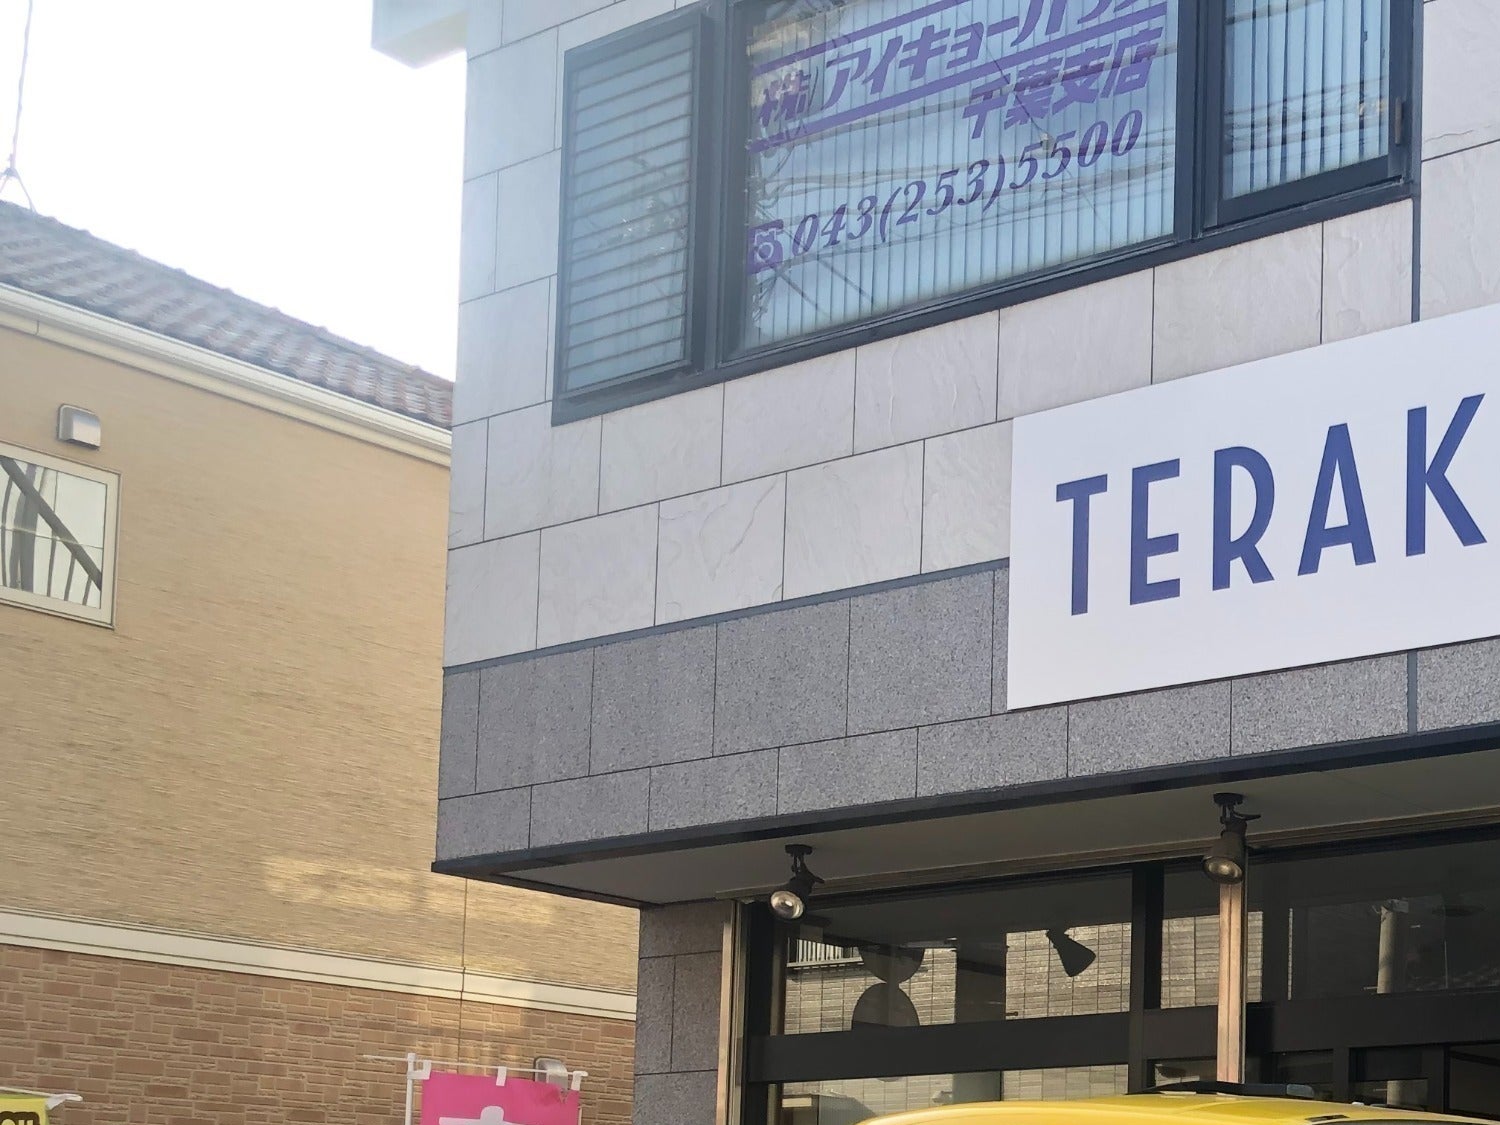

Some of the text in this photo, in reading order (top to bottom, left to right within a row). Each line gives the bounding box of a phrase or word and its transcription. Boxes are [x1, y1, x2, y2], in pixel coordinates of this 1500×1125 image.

[962, 26, 1163, 139] 千葉支店
[792, 110, 1143, 257] 043(253)5500
